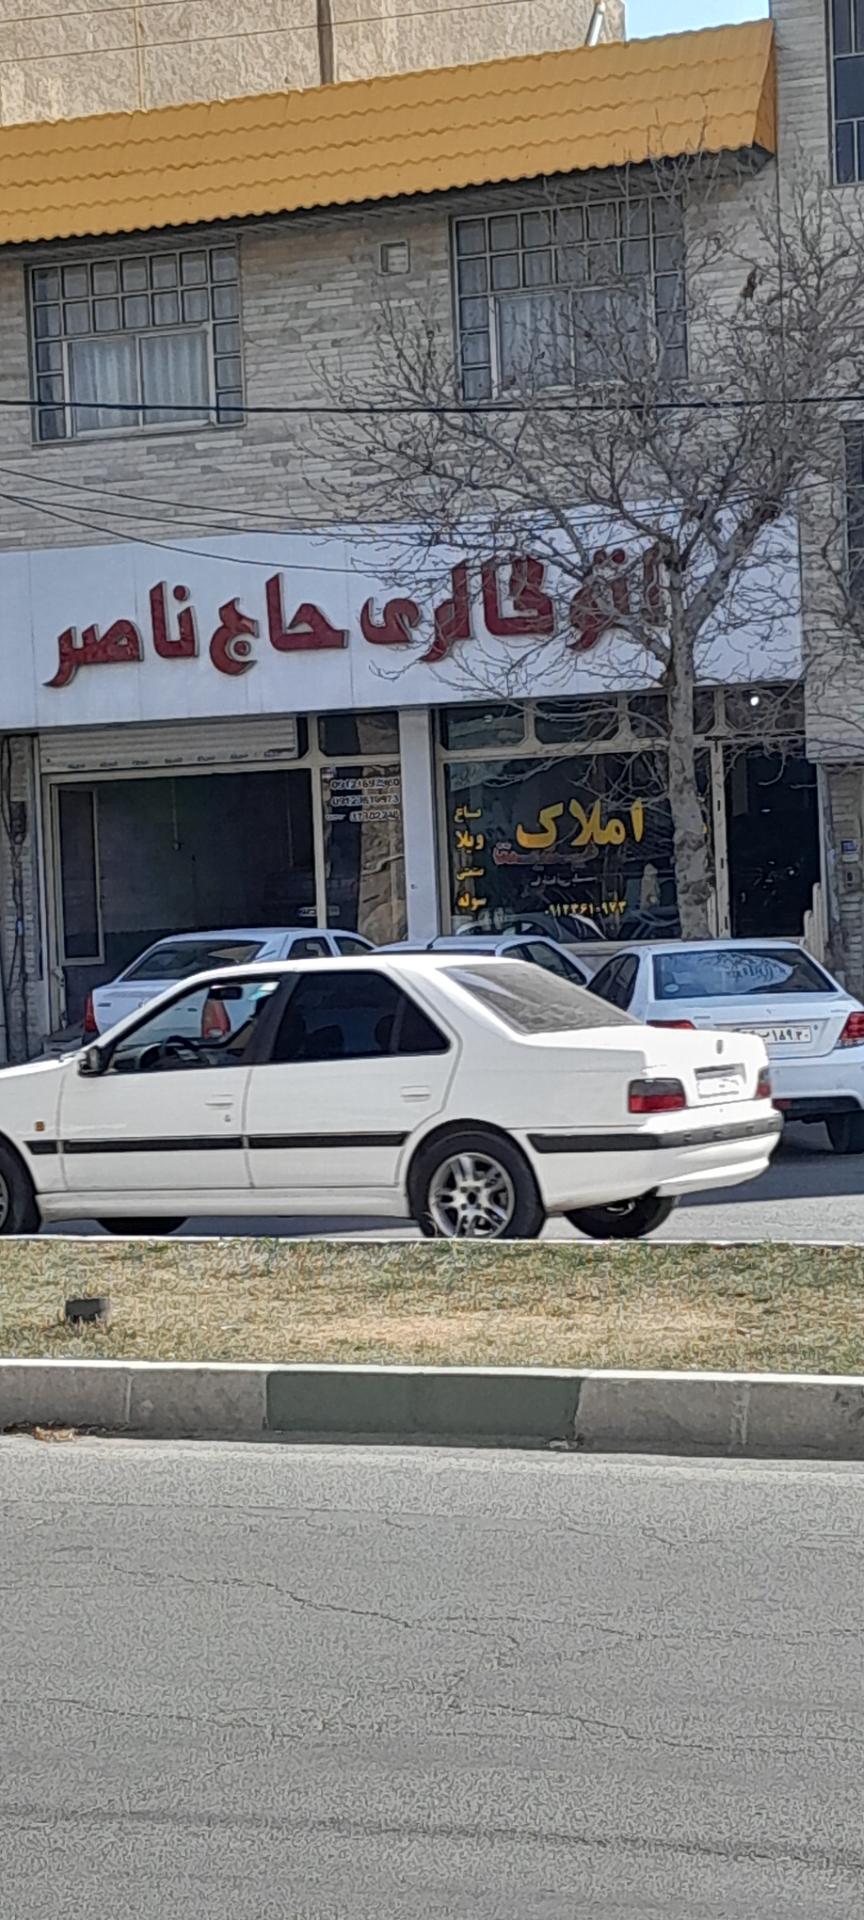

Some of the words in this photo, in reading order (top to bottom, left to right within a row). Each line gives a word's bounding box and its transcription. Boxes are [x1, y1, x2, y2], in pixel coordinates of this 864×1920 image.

[43, 580, 200, 688] ناصر
[209, 572, 350, 676] حاج
[456, 830, 486, 852] ویلا
[516, 798, 645, 849] املاک
